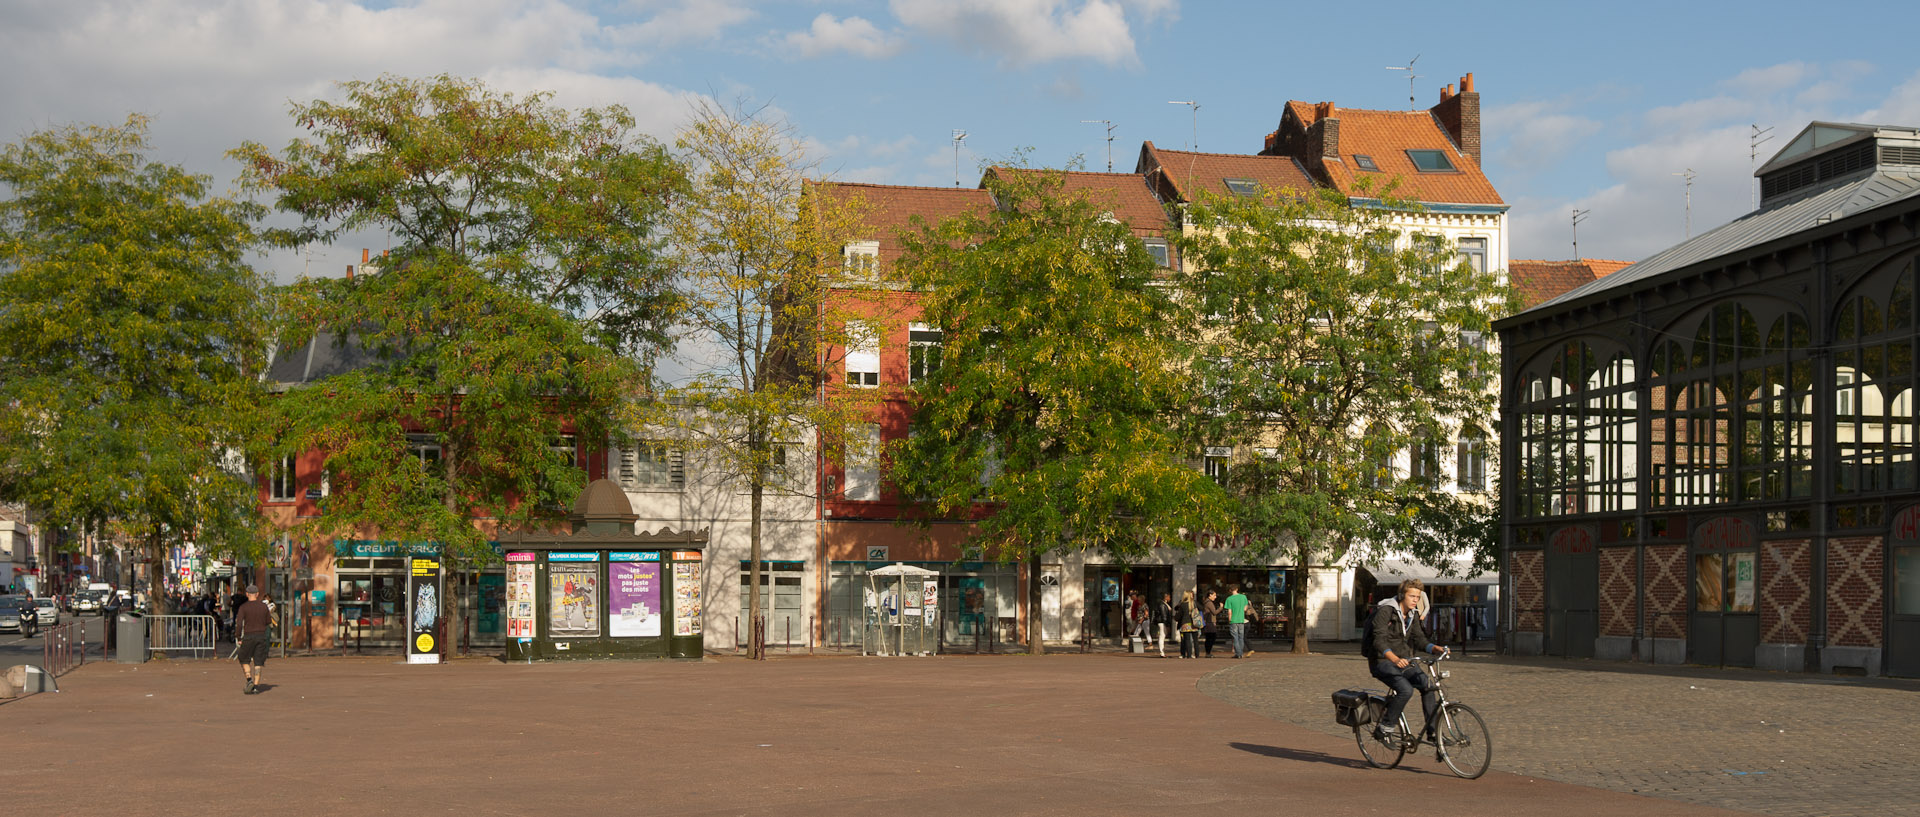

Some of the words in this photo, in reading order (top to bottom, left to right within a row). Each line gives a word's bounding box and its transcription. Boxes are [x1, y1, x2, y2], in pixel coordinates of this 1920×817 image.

[676, 552, 685, 560] TV
[870, 549, 886, 557] CA
[633, 579, 649, 587] juste
